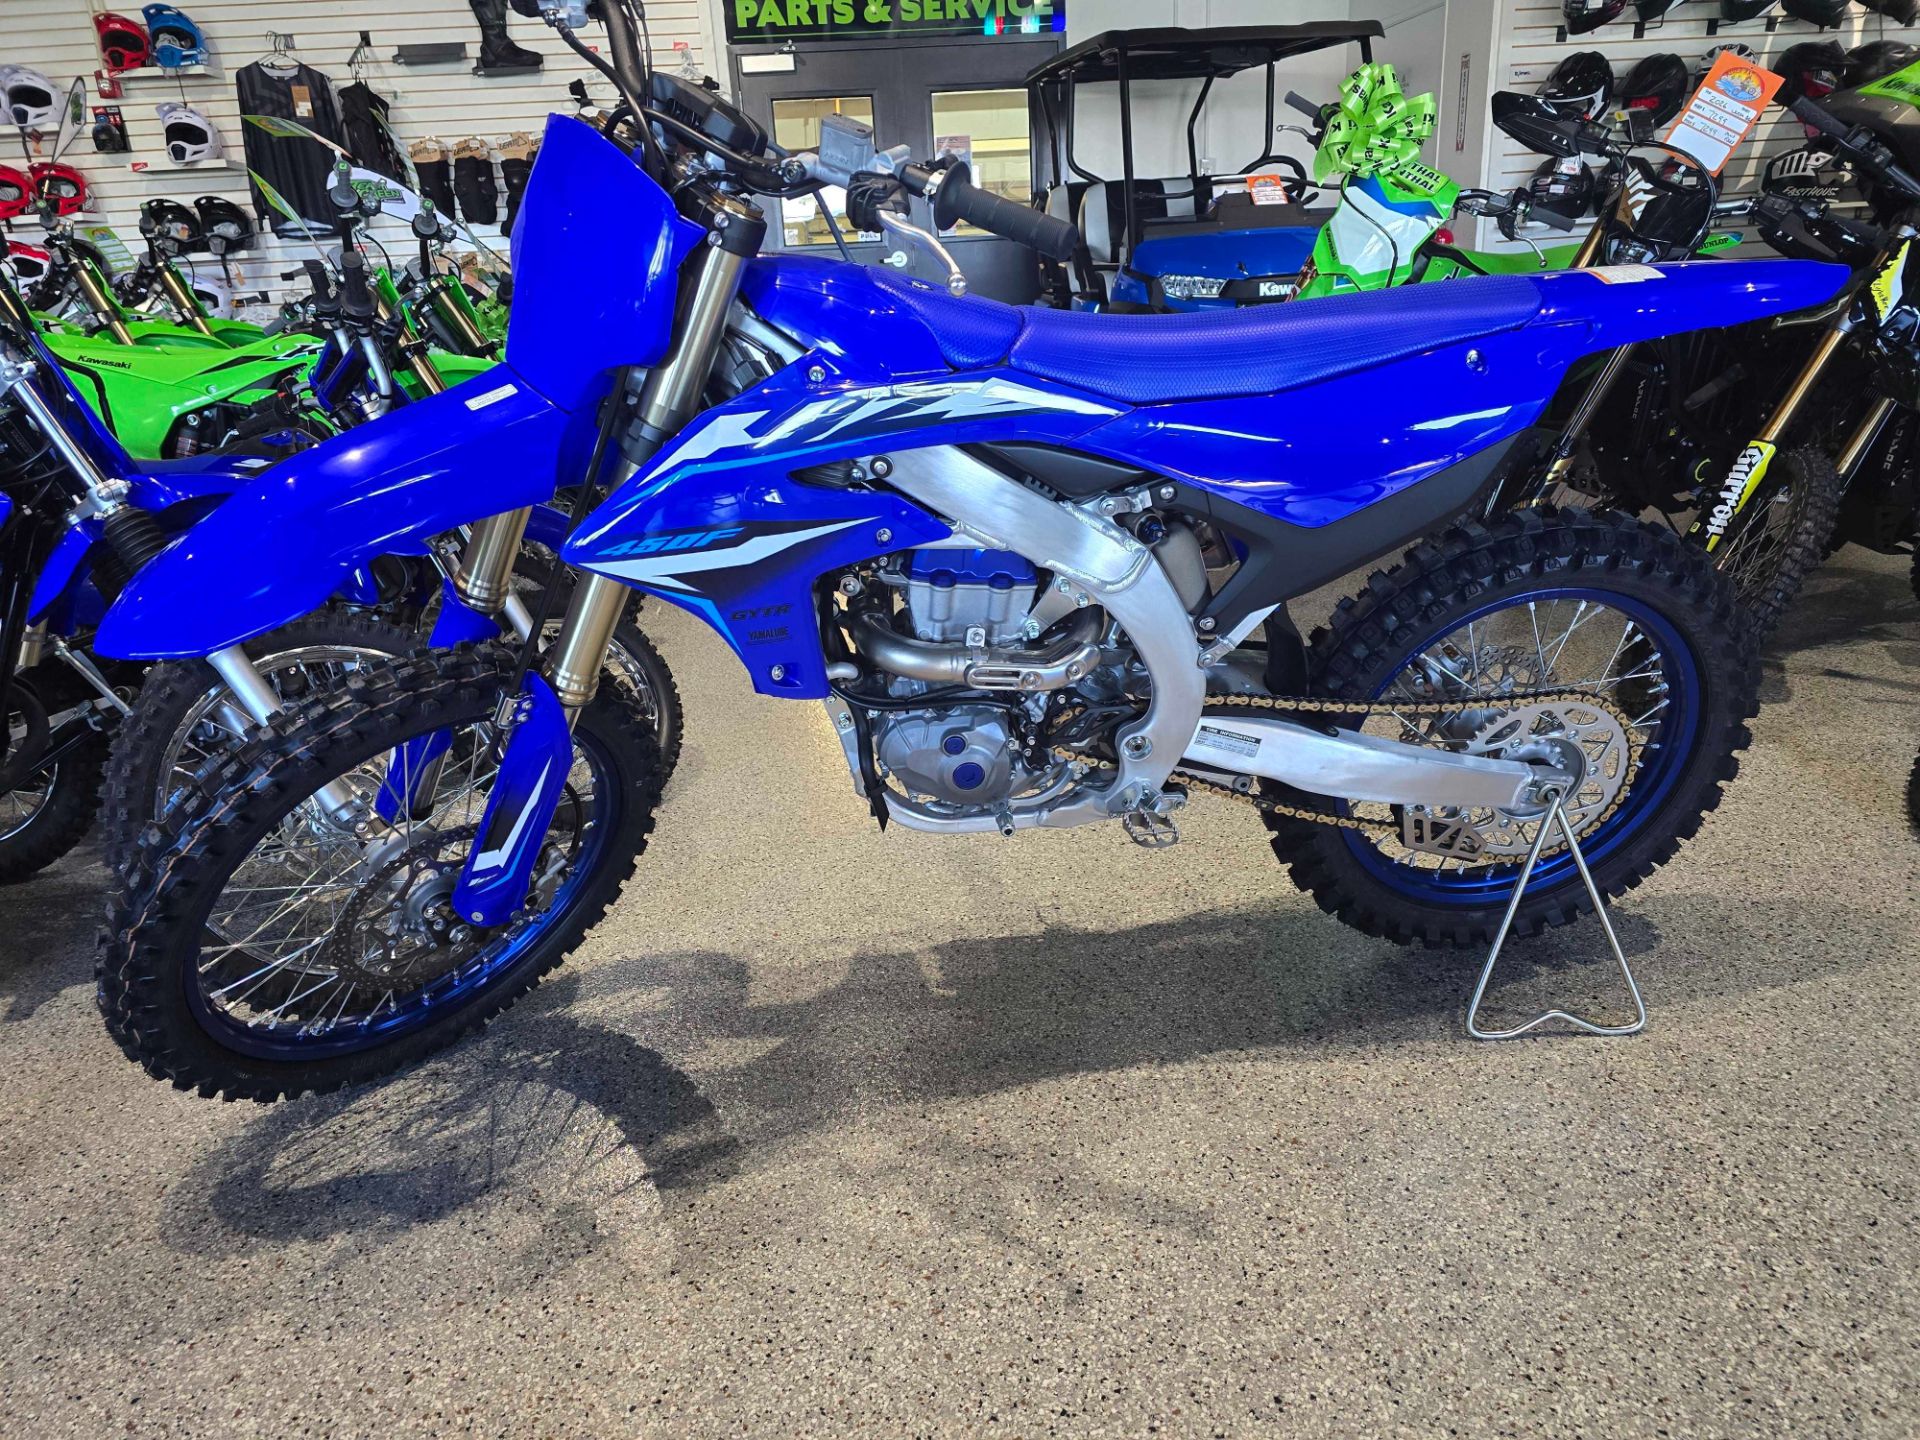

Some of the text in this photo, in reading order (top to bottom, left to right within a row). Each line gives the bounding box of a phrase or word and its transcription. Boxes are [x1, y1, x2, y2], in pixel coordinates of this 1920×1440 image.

[736, 0, 854, 28] PARTS
[863, 0, 893, 23] &
[1700, 238, 1728, 250] UNLOP
[78, 355, 132, 369] Kawasaki
[595, 527, 746, 556] 450F
